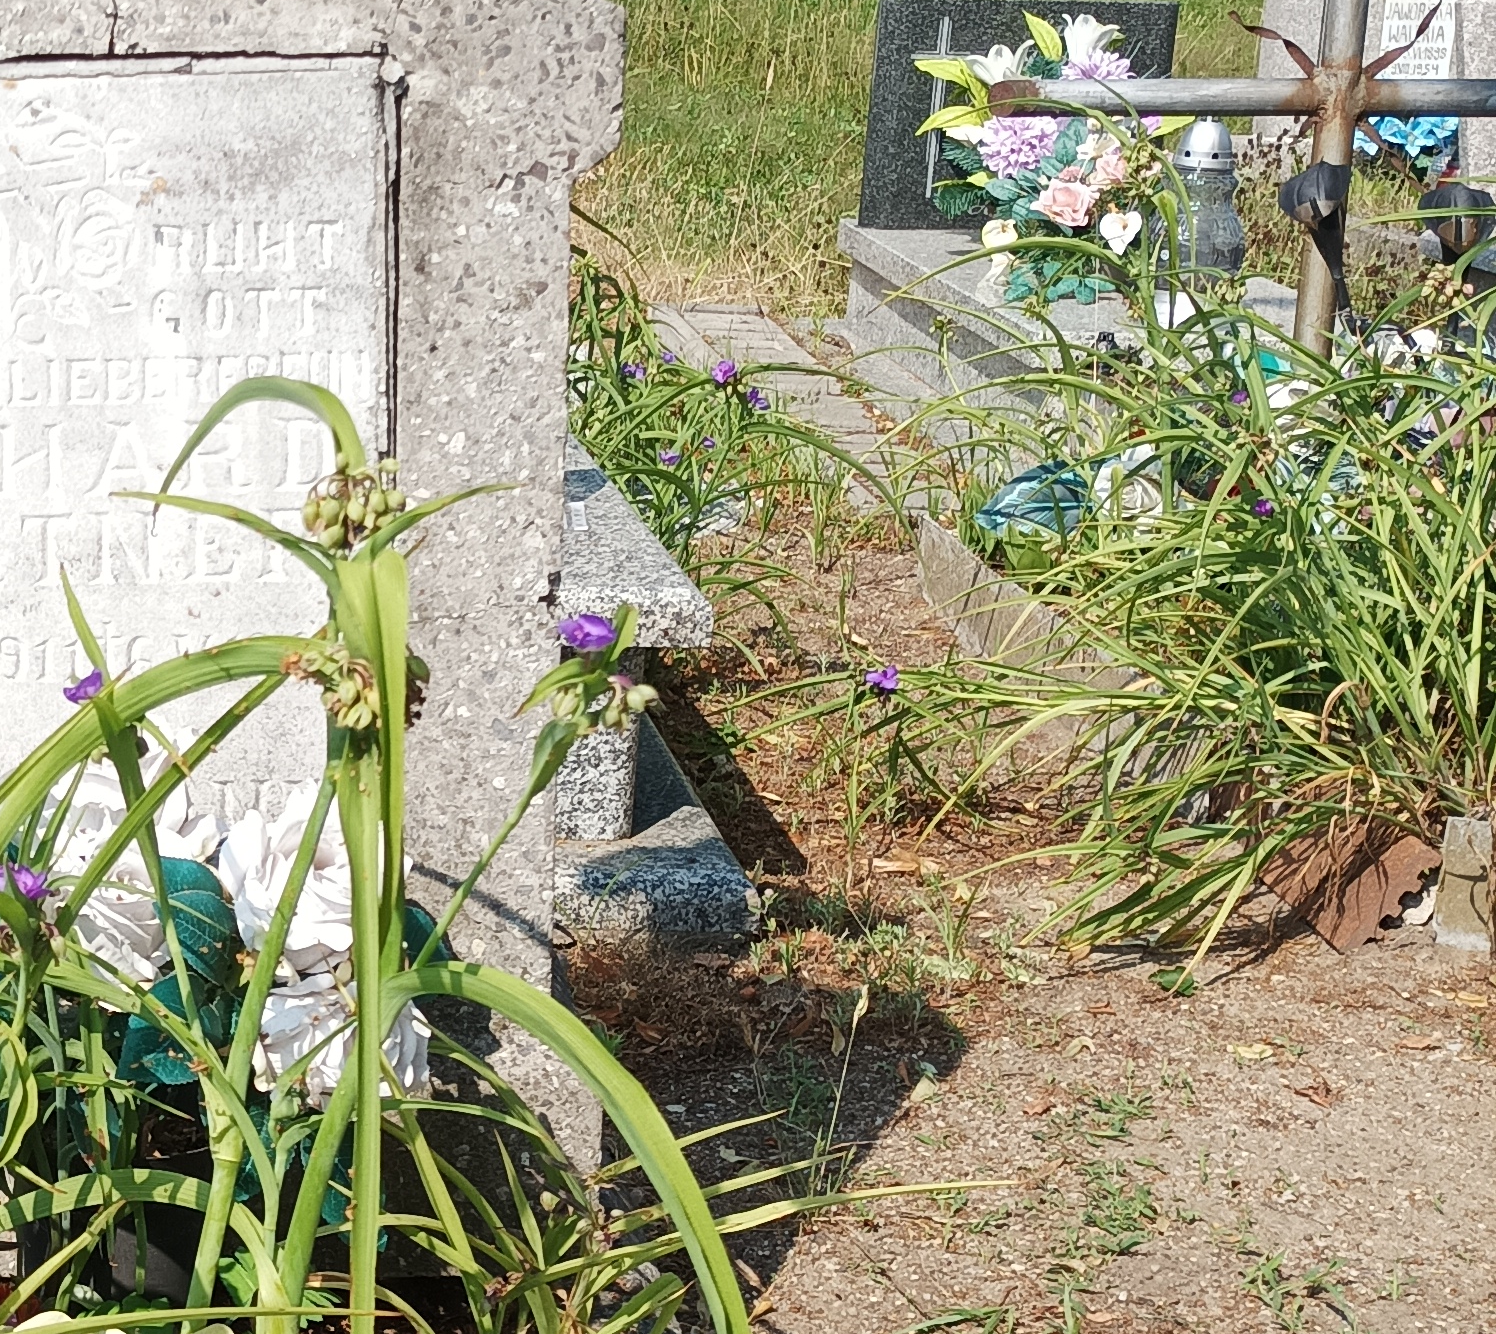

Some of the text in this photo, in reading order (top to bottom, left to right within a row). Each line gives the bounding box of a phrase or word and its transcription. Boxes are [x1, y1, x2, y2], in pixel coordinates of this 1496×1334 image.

[1386, 2, 1454, 21] JAWORKA
[1388, 24, 1446, 44] WALRIA
[152, 219, 344, 273] RUHT
[149, 286, 326, 340] GOTT
